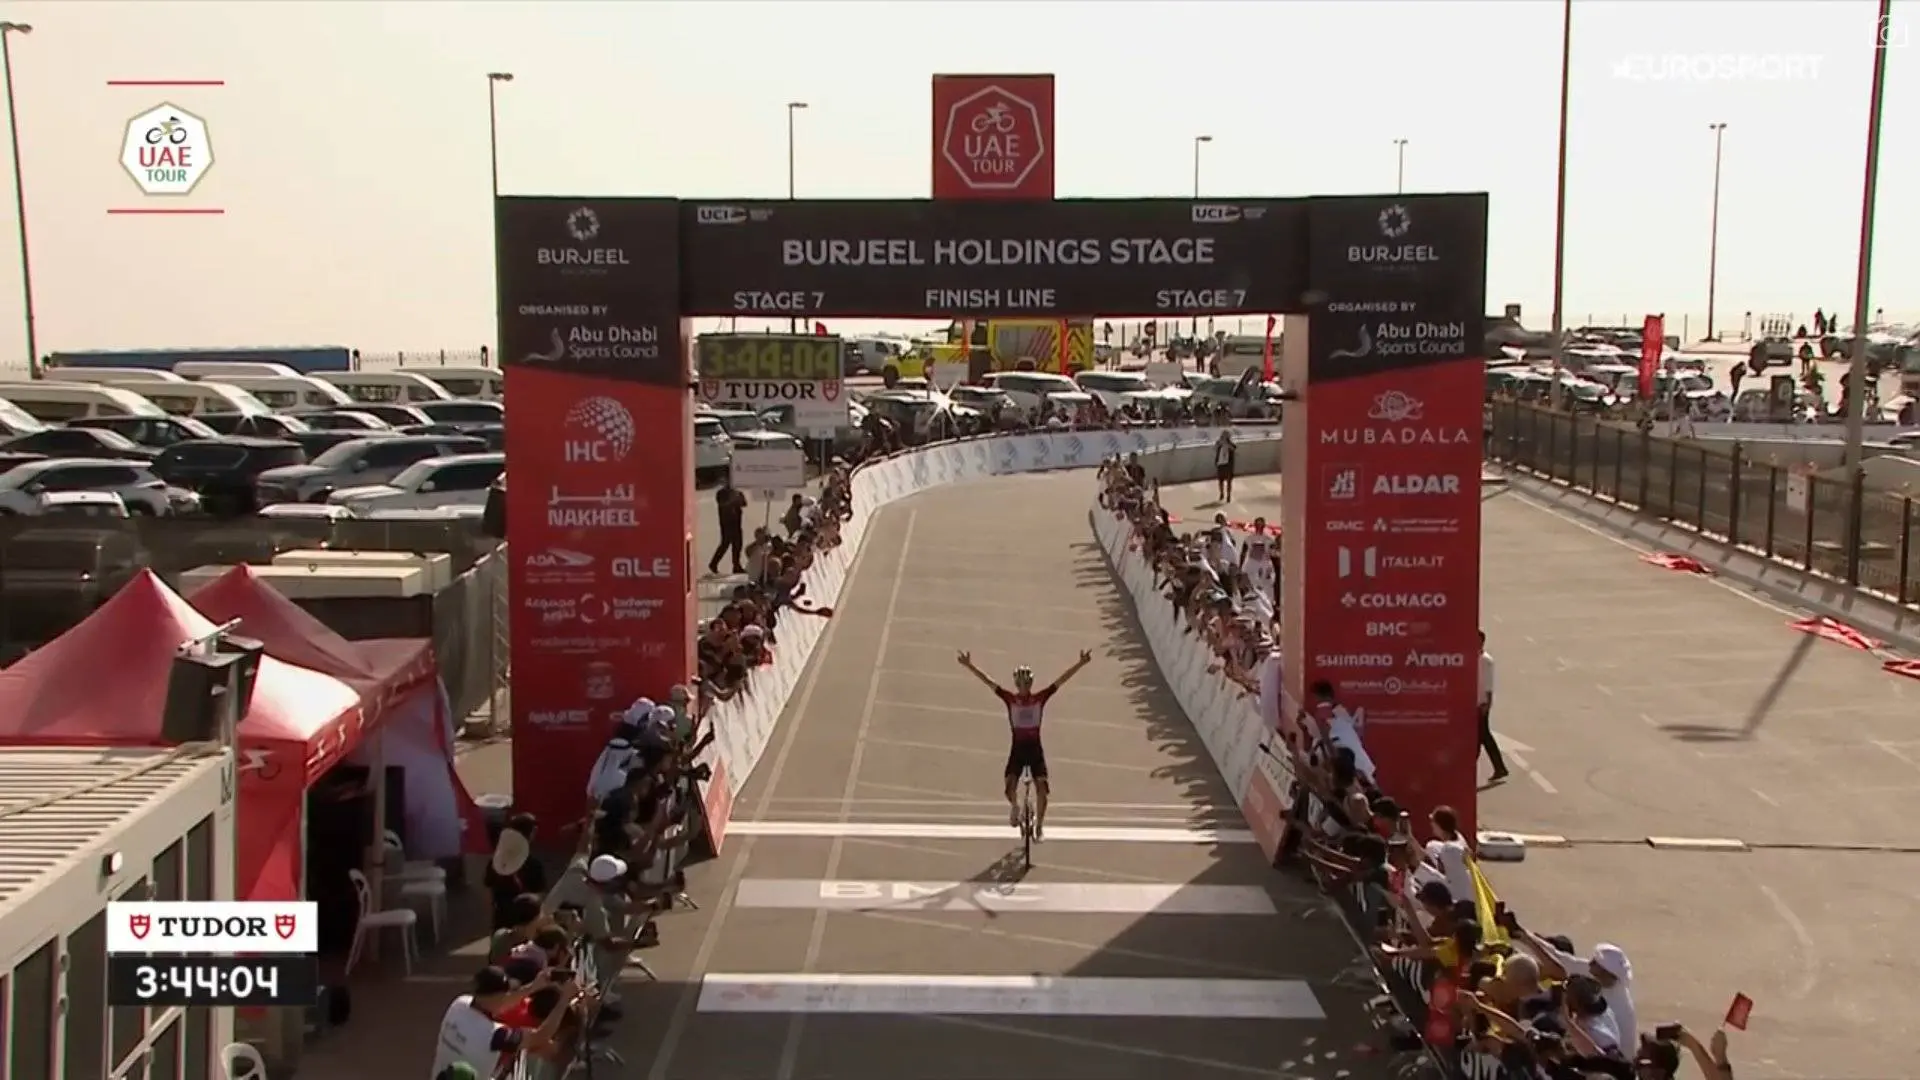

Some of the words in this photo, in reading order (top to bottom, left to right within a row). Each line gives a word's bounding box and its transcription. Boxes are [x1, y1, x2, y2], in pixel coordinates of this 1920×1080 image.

[964, 135, 1020, 158] UAE
[972, 159, 1015, 173] TOUR
[701, 208, 728, 220] UCI
[1196, 207, 1222, 219] UCI
[537, 248, 630, 264] BURJEEL
[782, 240, 925, 265] BURJEEL
[934, 239, 1100, 265] HOLDINGS
[1110, 238, 1215, 264] STAGE
[1347, 246, 1439, 262] BURJEEL
[733, 291, 805, 310] STAGE
[812, 291, 826, 309] 7
[925, 289, 999, 308] FINISH
[1007, 289, 1056, 308] LINE
[1156, 290, 1227, 308] STAGE
[1234, 290, 1246, 308] 7
[1328, 302, 1398, 312] ORGANISED
[1401, 302, 1416, 312] BY
[519, 305, 589, 315] ORGANISED
[592, 305, 608, 315] BY
[569, 326, 603, 342] Abu
[609, 325, 657, 342] Dhabi
[1376, 322, 1411, 338] Abu
[1415, 322, 1464, 338] Dhabi
[569, 345, 610, 362] Sports
[613, 345, 658, 358] Council
[1376, 340, 1417, 357] Sports
[1419, 340, 1464, 354] Council
[704, 342, 838, 378] 3:44:04
[726, 382, 817, 399] TUDOR
[1320, 428, 1471, 444] MUBADALA
[564, 440, 607, 462] IHC
[1372, 475, 1460, 495] ALDAR
[548, 509, 640, 526] NAKHEEL
[1382, 556, 1444, 568] ITALIA.IT
[1360, 593, 1447, 608] COLNAGO
[1366, 622, 1408, 636] BMC
[1405, 649, 1464, 667] Arena
